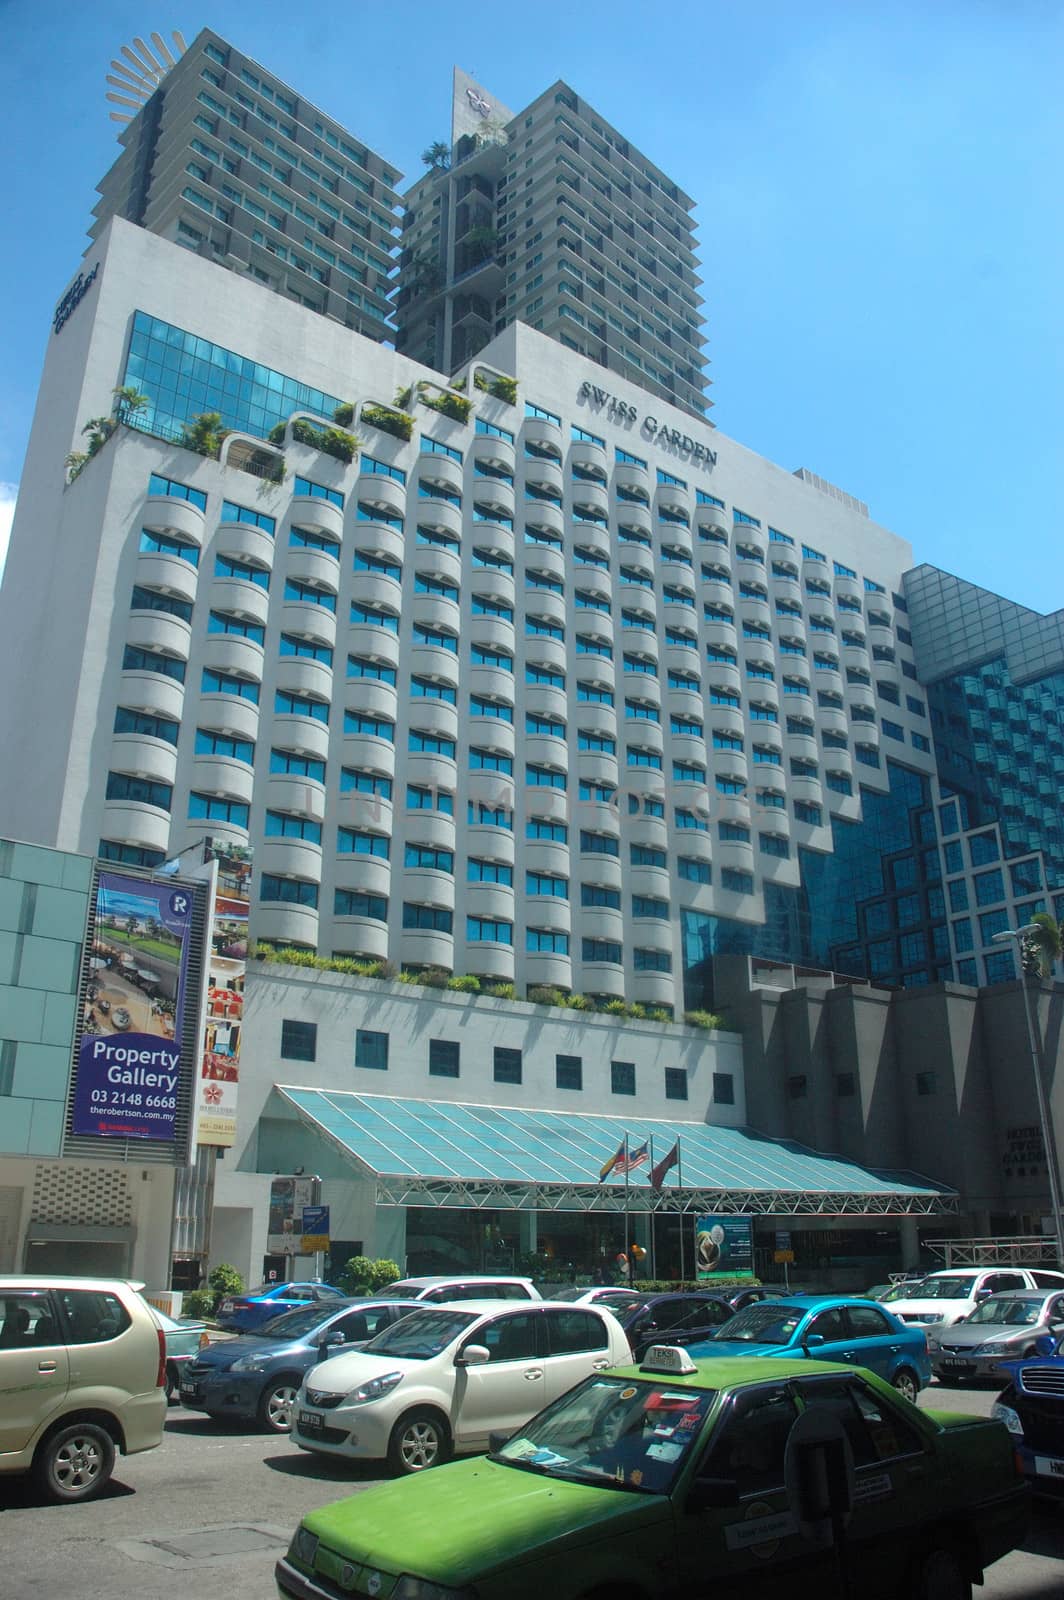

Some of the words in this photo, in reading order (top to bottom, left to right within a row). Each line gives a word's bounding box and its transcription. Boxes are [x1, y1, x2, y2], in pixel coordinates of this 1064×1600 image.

[580, 381, 638, 423] SWISS
[643, 415, 718, 466] GARDEN
[93, 1041, 180, 1070] Property
[107, 1065, 178, 1093] Gallery
[91, 1089, 108, 1103] 03
[111, 1091, 142, 1106] 2148
[145, 1095, 176, 1109] 6668
[90, 1106, 175, 1122] therobertson.com.my
[654, 1348, 674, 1358] TEKSI
